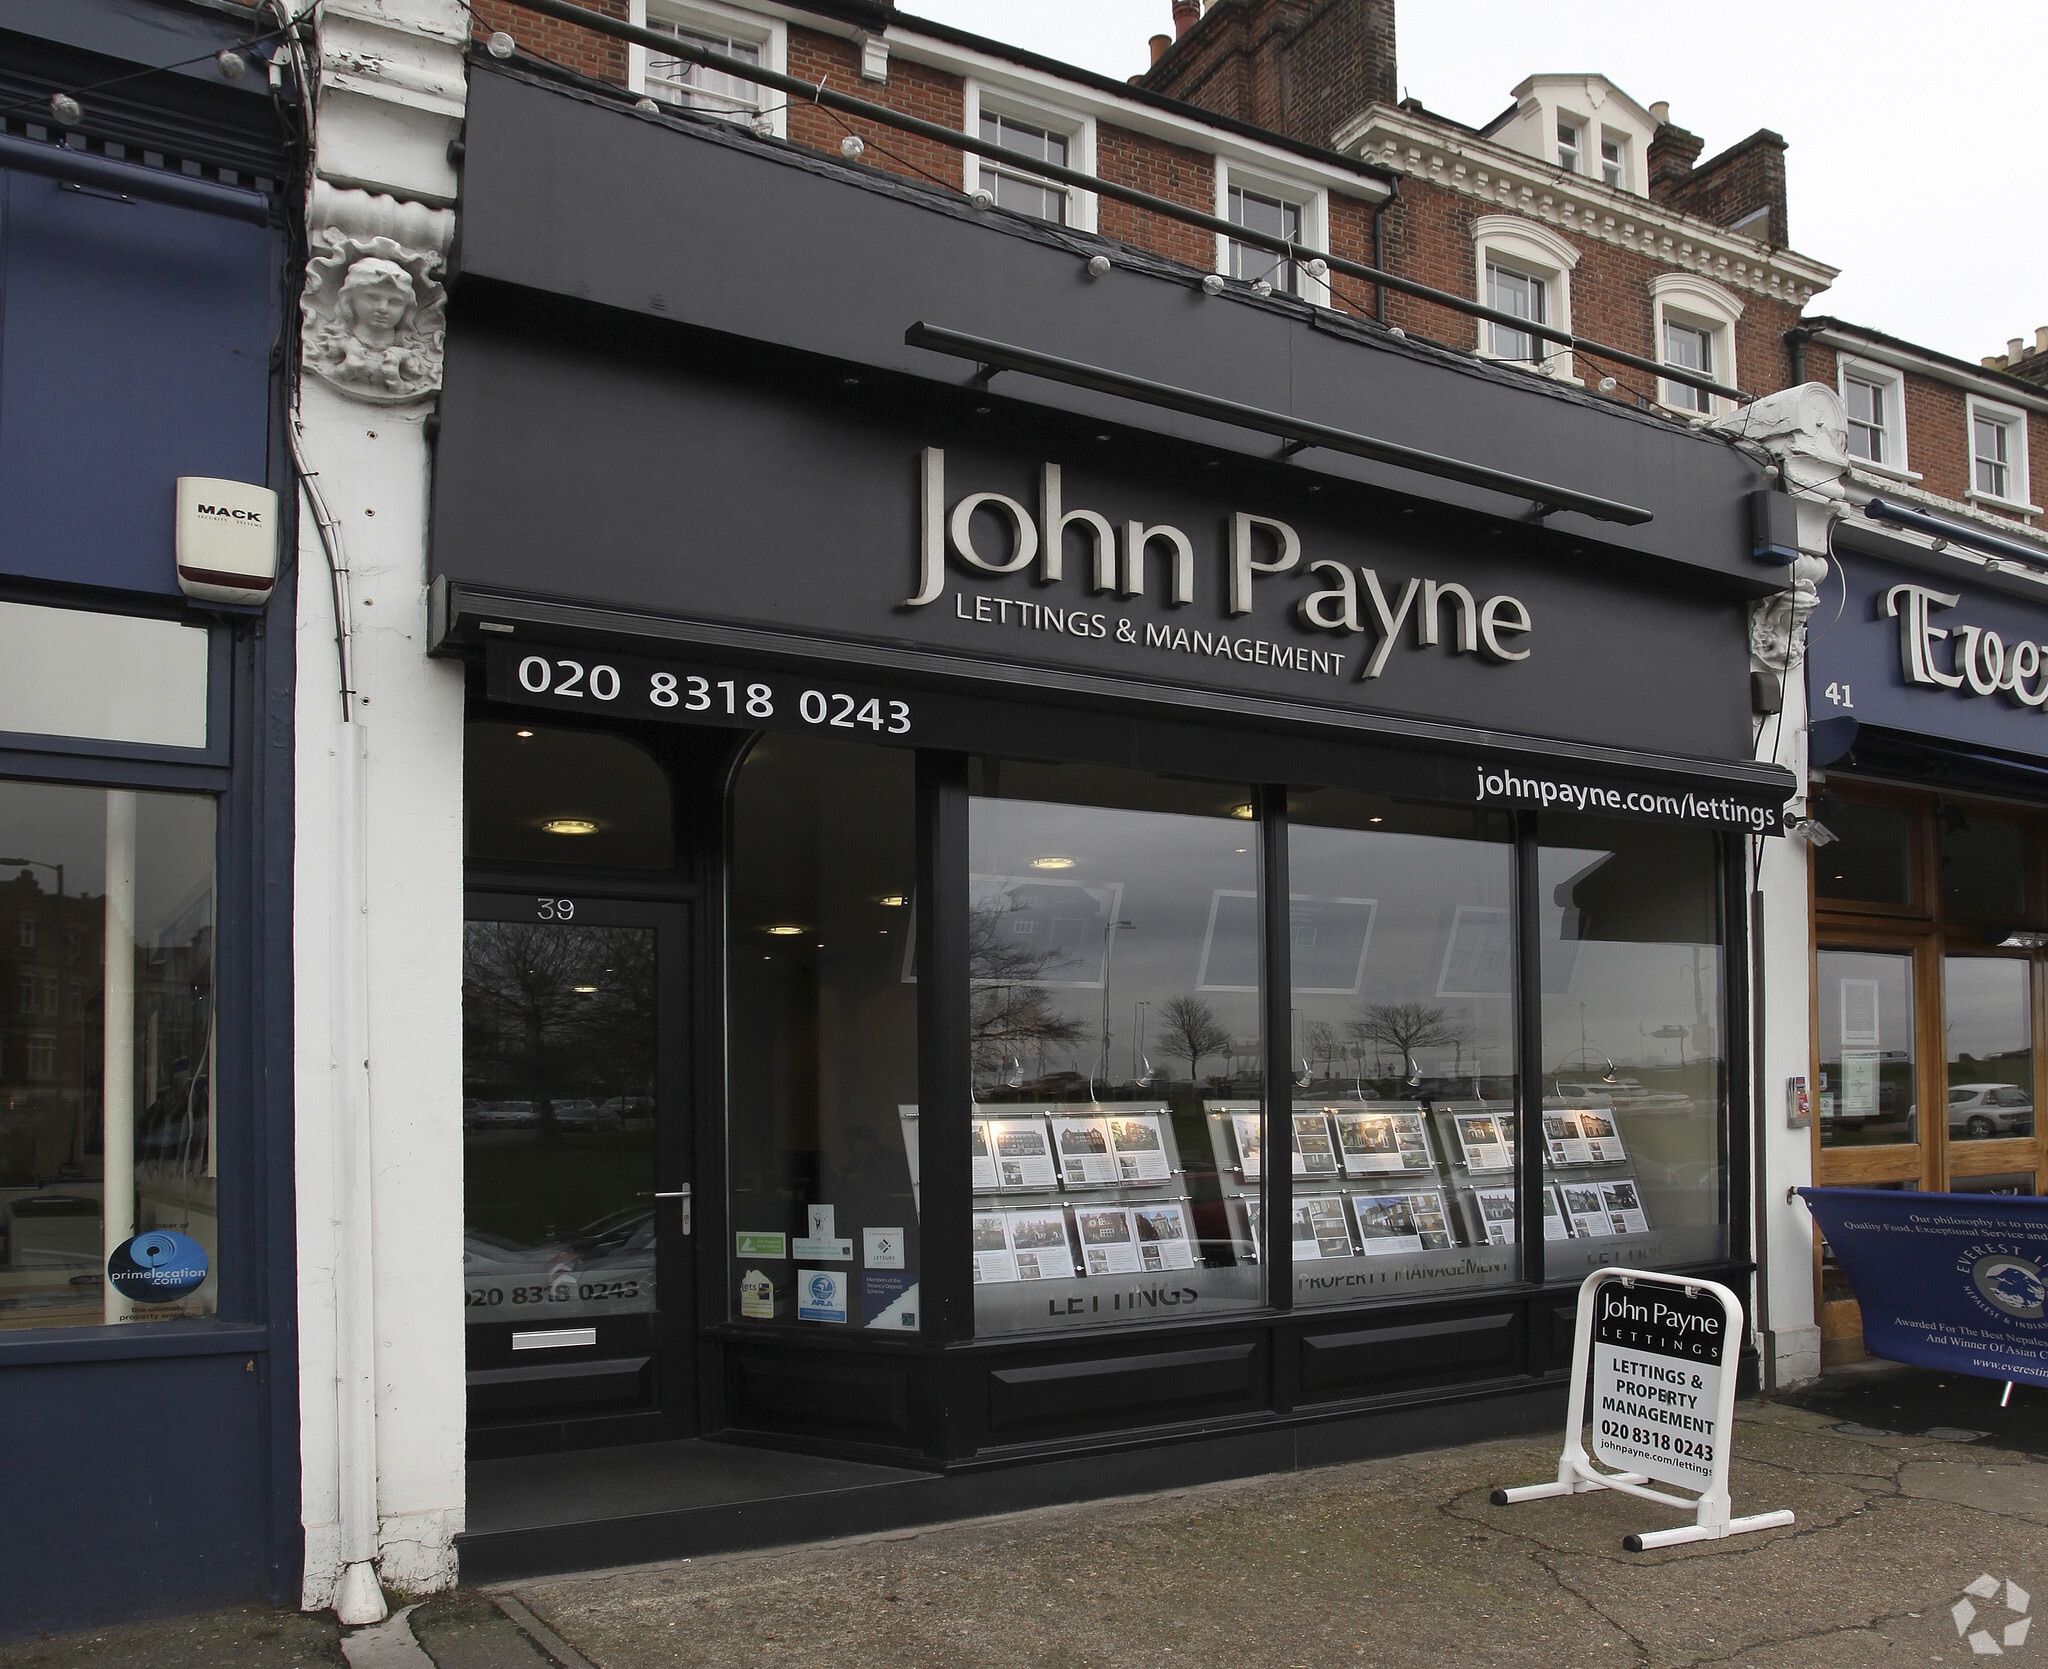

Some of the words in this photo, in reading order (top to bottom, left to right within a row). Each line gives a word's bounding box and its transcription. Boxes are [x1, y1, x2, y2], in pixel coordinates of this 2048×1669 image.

[197, 504, 262, 523] MACK
[904, 446, 1194, 606] John
[1229, 511, 1532, 680] Payne
[956, 592, 1107, 639] LETTINGS
[1115, 617, 1138, 645] &
[1145, 621, 1346, 676] MANAGEMENT
[518, 655, 621, 701] 020
[649, 671, 775, 719] 8318
[799, 690, 912, 735] 0243
[1824, 682, 1854, 708] 41
[1476, 765, 1776, 831] johnpayne.com/lettings
[537, 898, 575, 920] 39
[1843, 1221, 1881, 1232] Quality
[1916, 1225, 1979, 1237] Exceptional
[1980, 1227, 2024, 1239] Service
[1909, 1214, 1931, 1224] Our
[1933, 1215, 1993, 1228] philosophy
[1996, 1218, 2006, 1228] is
[2009, 1220, 2021, 1228] to
[1956, 1243, 2022, 1274] EVEREST
[111, 1267, 206, 1283] primelocation
[151, 1276, 182, 1286] .com
[511, 1284, 570, 1304] 8318
[578, 1281, 639, 1300] 0243
[811, 1299, 834, 1307] ARLA
[1963, 1286, 2001, 1320] NEPALESE
[1601, 1292, 1648, 1323] John
[1653, 1302, 1719, 1336] Payne
[1894, 1317, 1937, 1331] Awarded
[1939, 1323, 1957, 1334] For
[1958, 1325, 1978, 1337] The
[1981, 1329, 2004, 1341] Best
[1602, 1326, 1718, 1358] LETTINGS
[1926, 1333, 1947, 1345] And
[1949, 1336, 1988, 1351] Winner
[1990, 1342, 2005, 1353] Of
[2006, 1346, 2036, 1358] Asian
[1613, 1358, 1686, 1386] LETTINGS
[1691, 1374, 1703, 1390] &
[1616, 1379, 1698, 1410] PROPERTY
[1602, 1396, 1715, 1435] MANAGEMENT
[1601, 1419, 1629, 1440] 020
[1632, 1427, 1671, 1451] 8318
[1674, 1437, 1713, 1462] 0243
[1600, 1438, 1713, 1477] johnpayne.com/lettings
